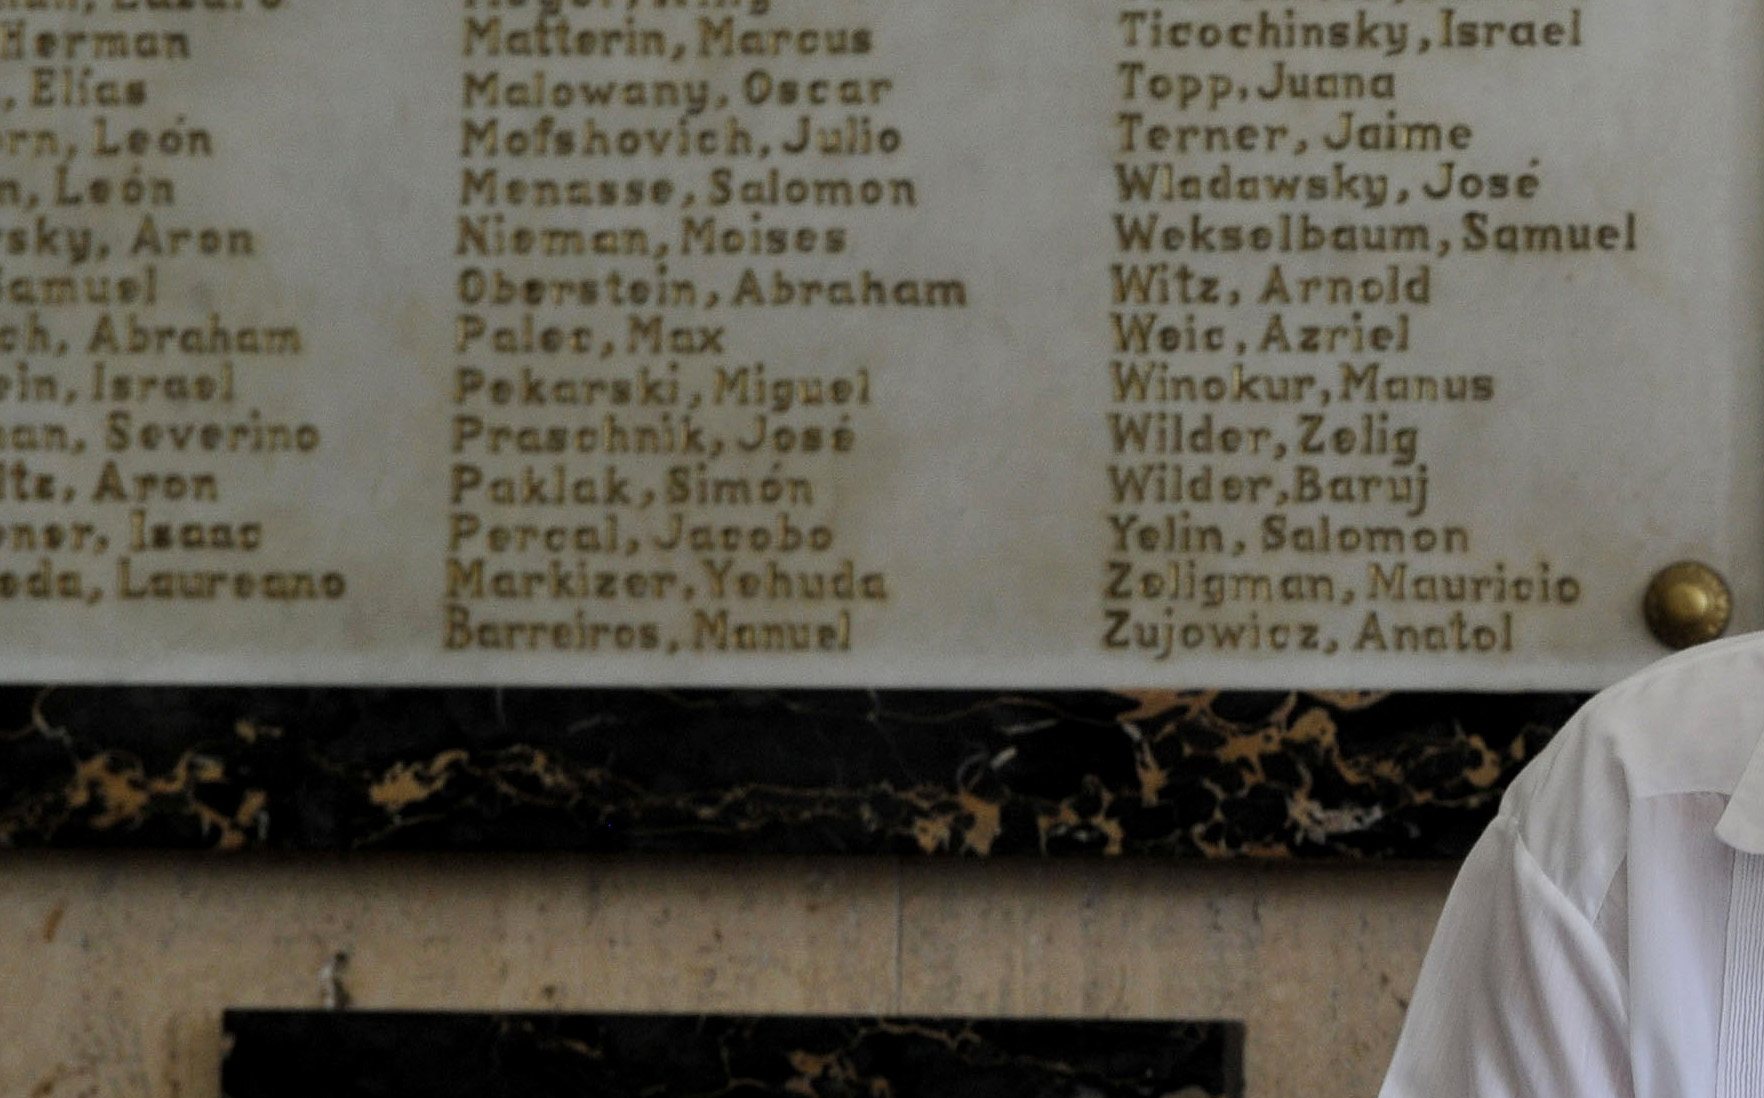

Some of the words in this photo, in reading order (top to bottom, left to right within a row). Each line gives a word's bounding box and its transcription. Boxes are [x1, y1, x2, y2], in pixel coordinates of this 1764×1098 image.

[742, 68, 894, 108] Oscar
[92, 116, 214, 157] León
[781, 115, 902, 157] Julio
[1321, 109, 1473, 153] Jaime
[55, 166, 176, 206] León
[130, 213, 255, 255] Aron
[1461, 211, 1638, 256] Samuel
[732, 266, 967, 307] Abraham
[1257, 262, 1431, 304] Arnold
[86, 312, 302, 354] Abraham
[626, 314, 724, 355] Max
[1258, 311, 1410, 354] Azriel
[713, 362, 871, 412] Miguel
[105, 409, 321, 453] Severino
[91, 460, 219, 502] Aron
[654, 512, 833, 553] Jacobo
[1260, 513, 1470, 554] Salomon
[117, 557, 348, 601] Laureano
[1366, 560, 1582, 603] Mauricio
[1352, 610, 1513, 653] Anatol
